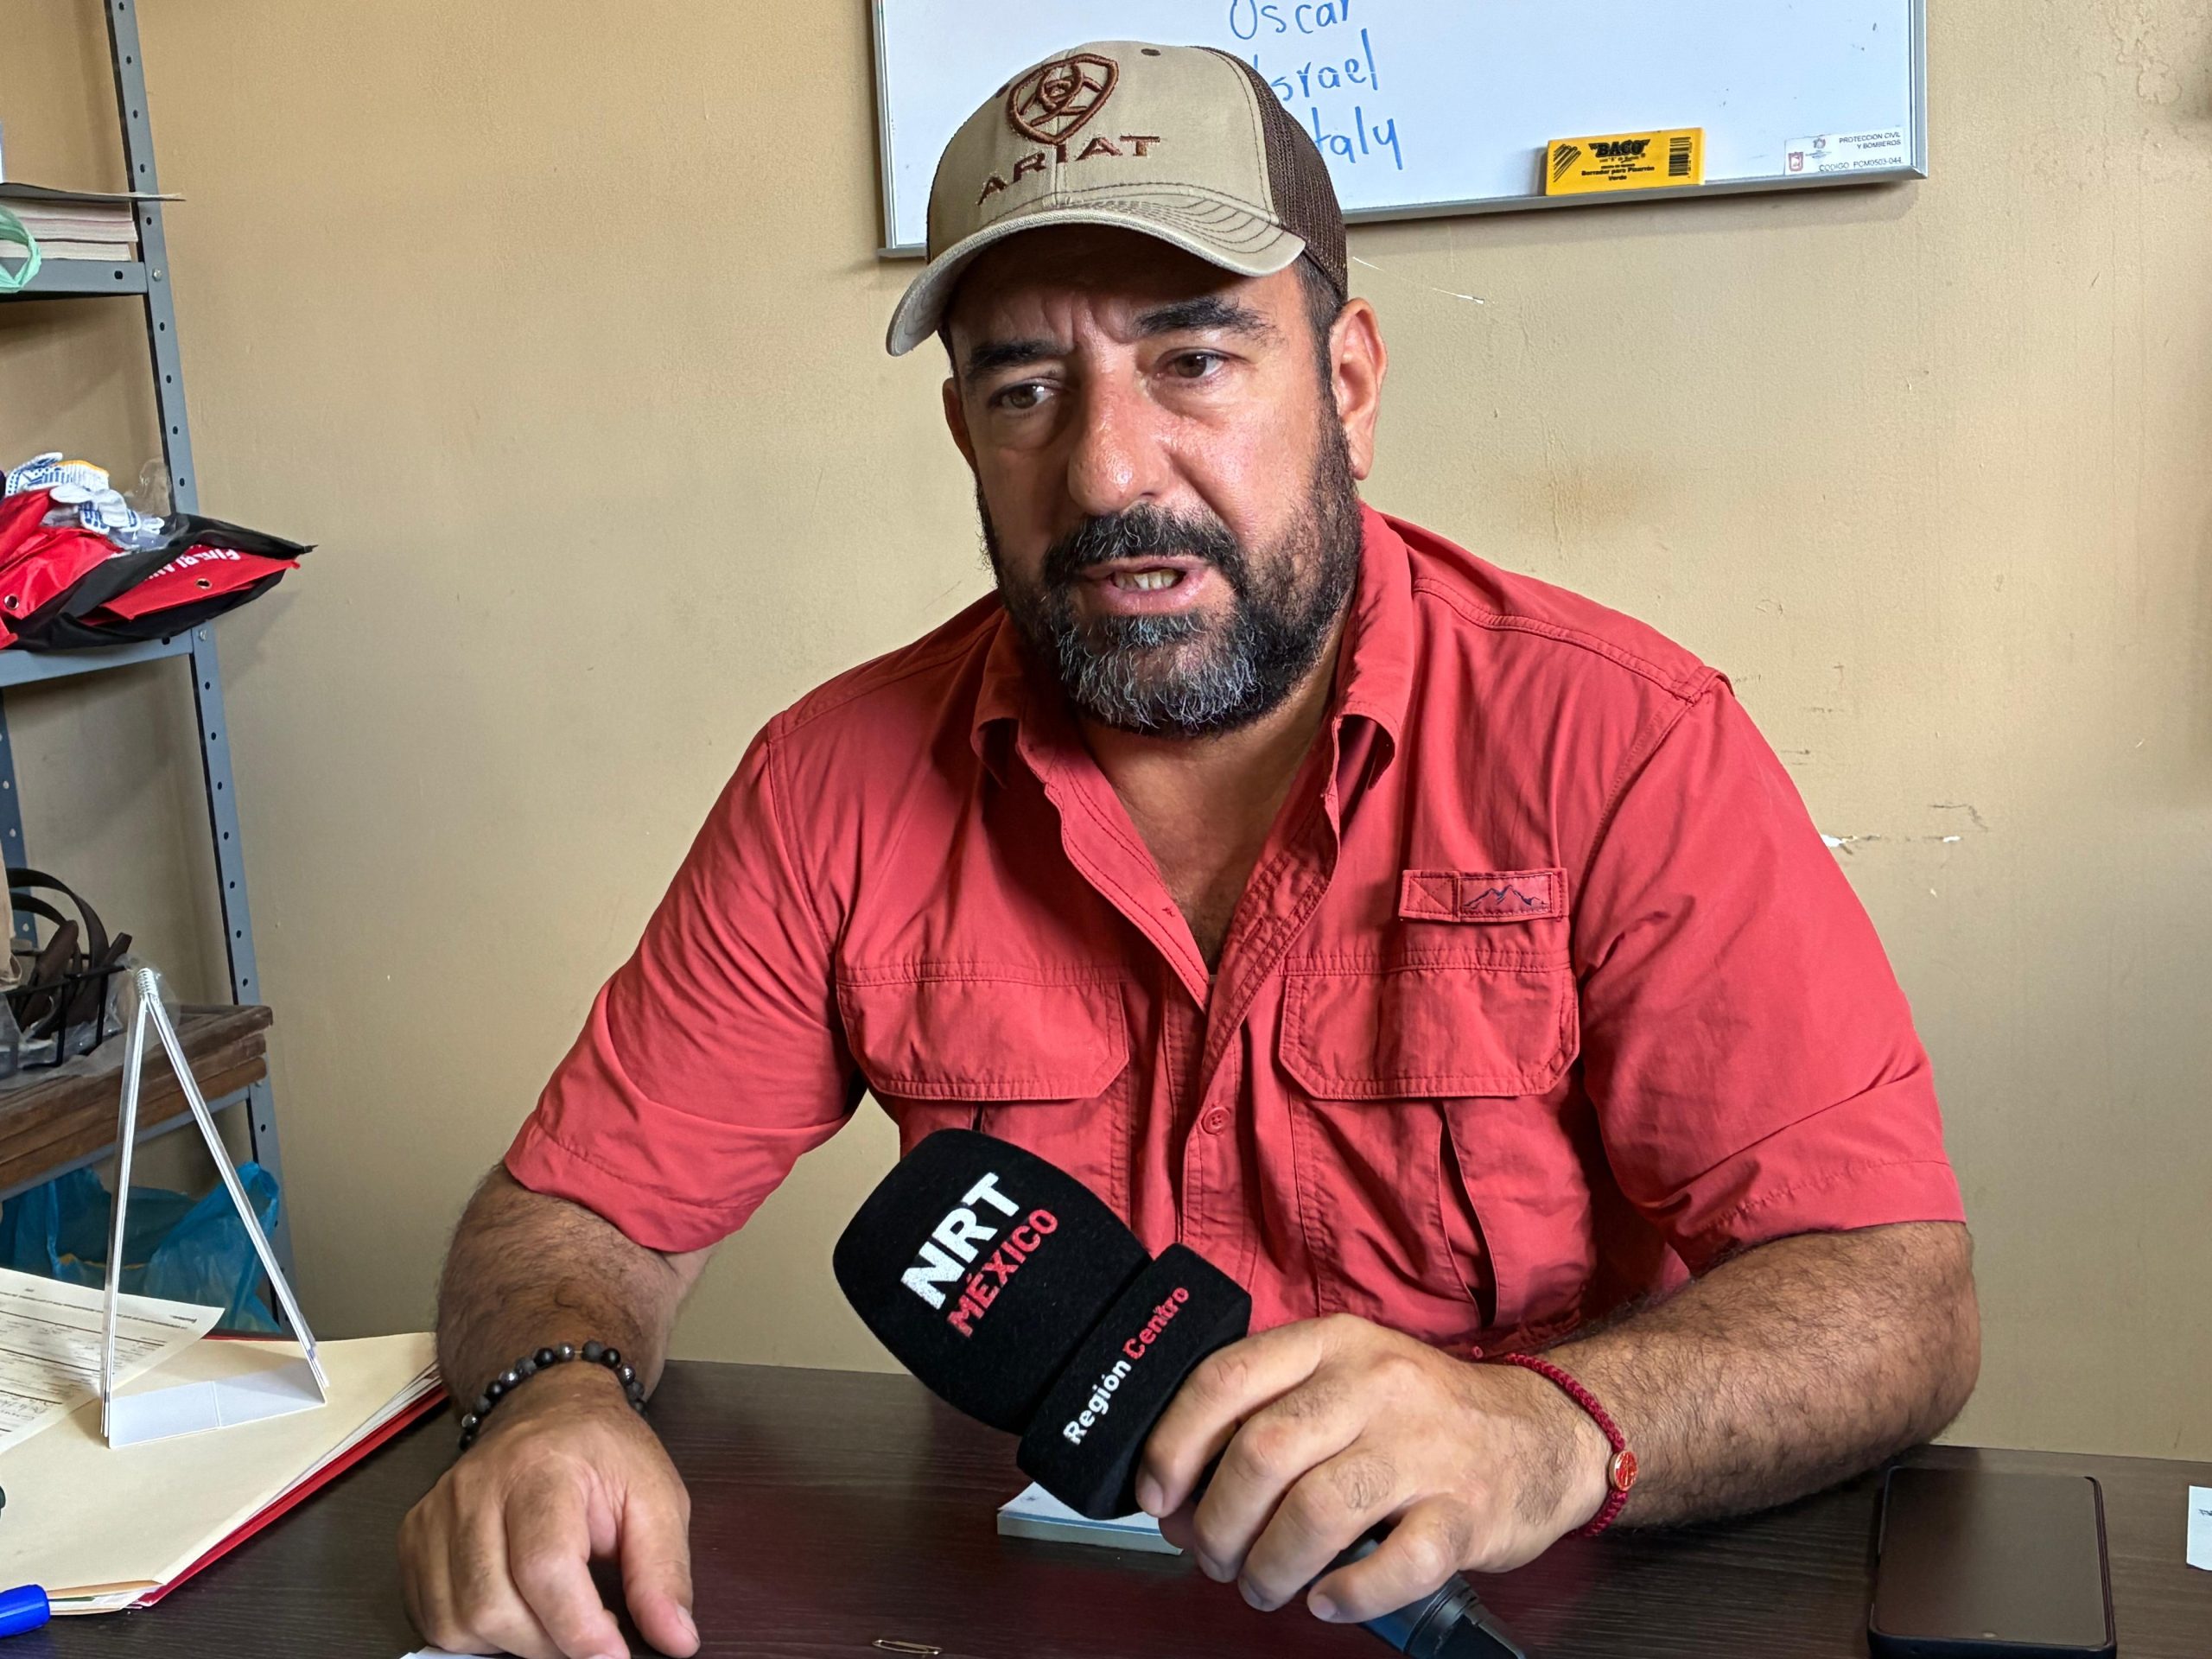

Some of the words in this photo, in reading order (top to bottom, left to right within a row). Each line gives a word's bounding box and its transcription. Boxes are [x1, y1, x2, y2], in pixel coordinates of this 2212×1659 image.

[1230, 0, 1351, 40] Oscar
[976, 134, 1161, 206] ARIAT
[1588, 139, 1650, 158] BACO
[1863, 139, 1901, 149] BOMBEROS
[899, 1171, 1020, 1311] NRT
[945, 1208, 1059, 1338] MÉXICO
[1063, 1359, 1132, 1446] Región
[1122, 1286, 1190, 1361] Centro
